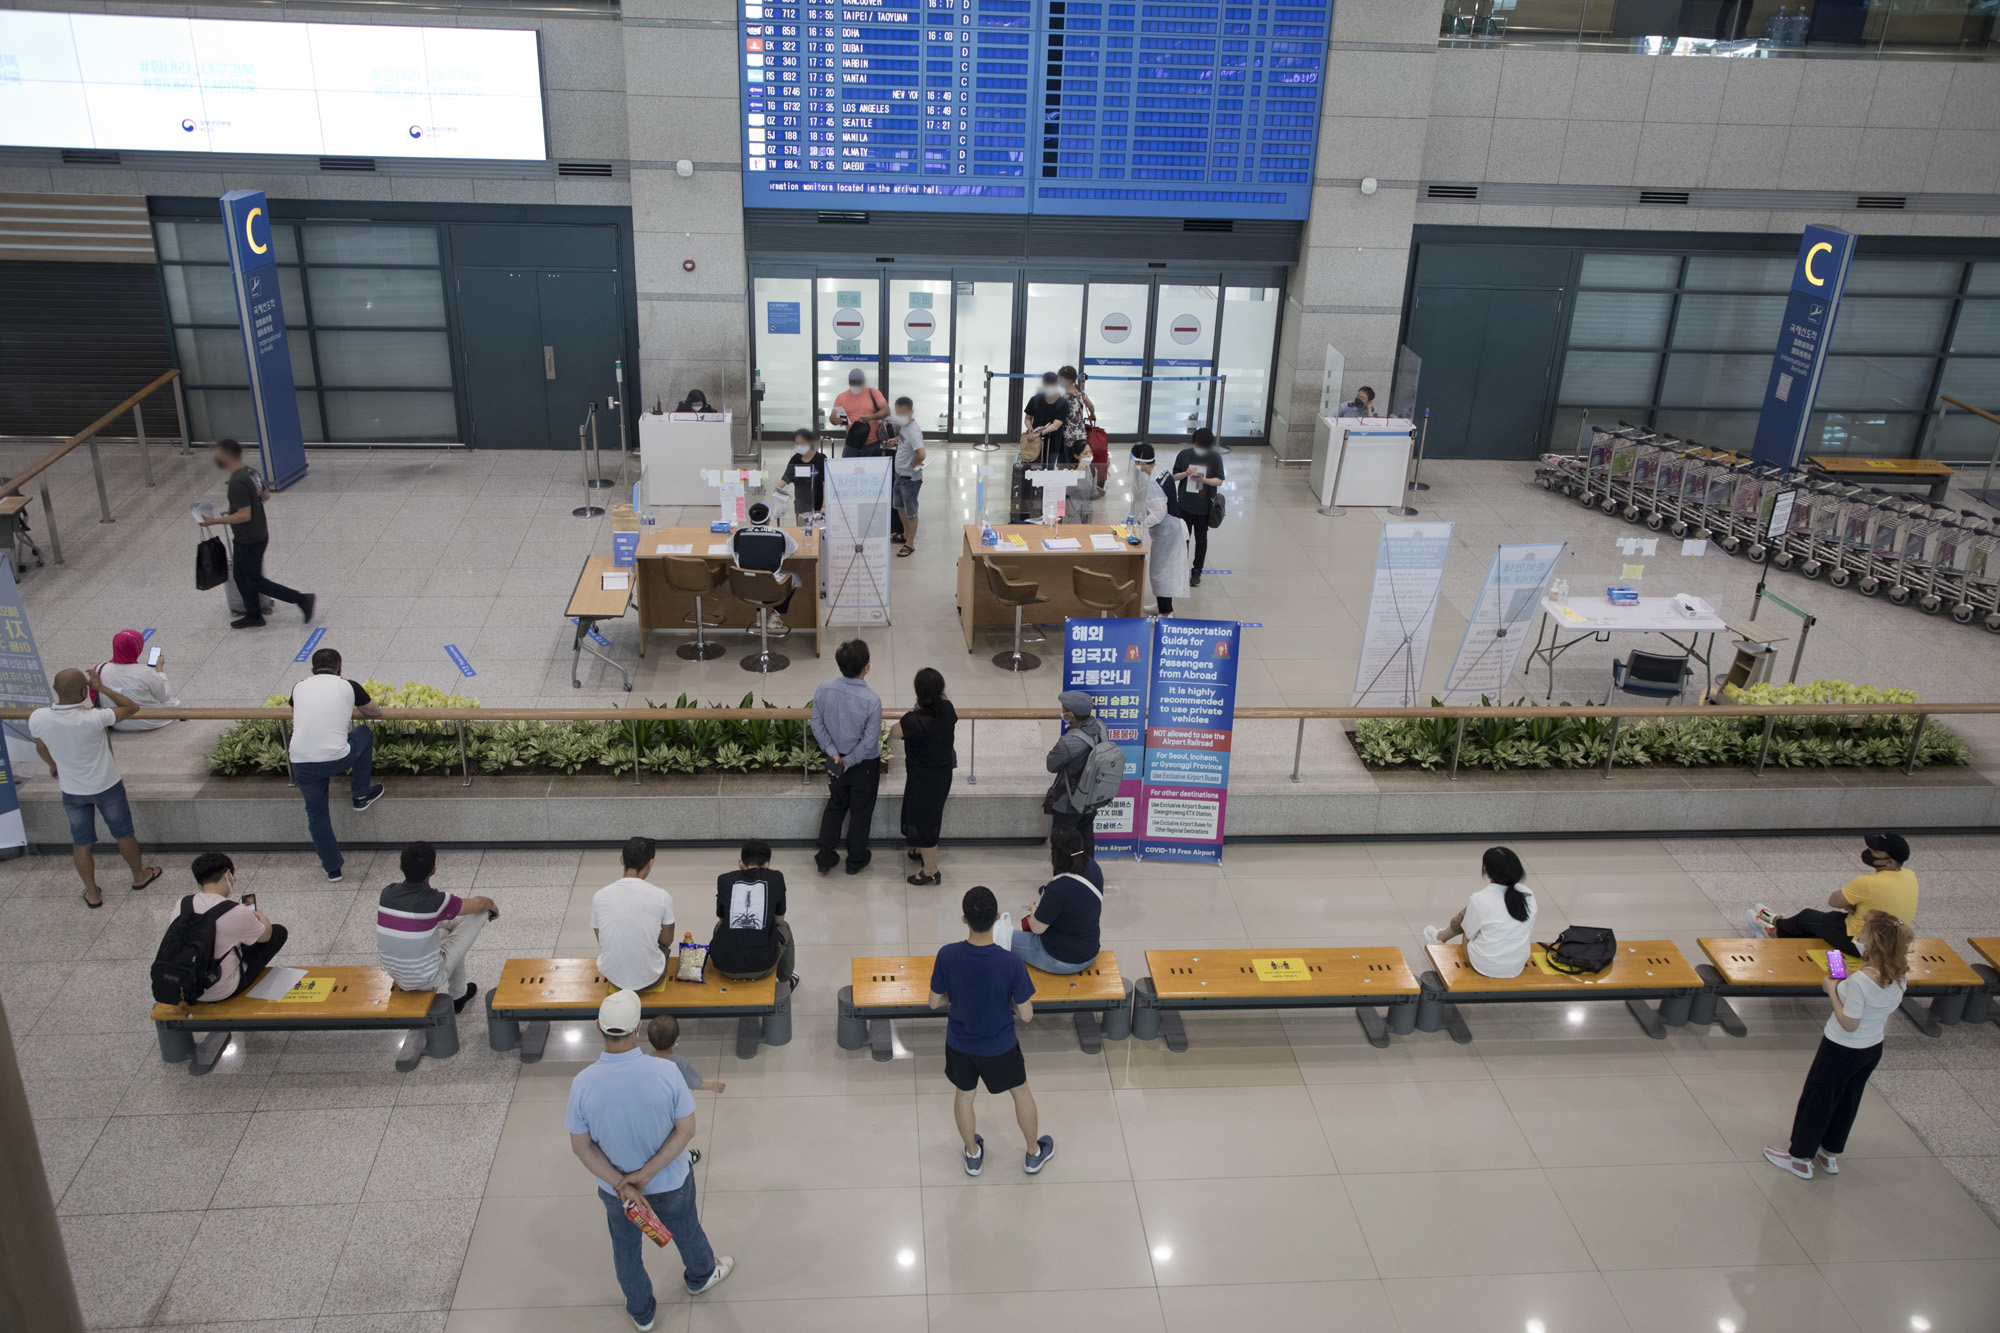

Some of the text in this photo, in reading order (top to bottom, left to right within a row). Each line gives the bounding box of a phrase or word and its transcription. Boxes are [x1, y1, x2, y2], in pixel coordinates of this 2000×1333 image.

[964, 0, 970, 8] D
[764, 8, 774, 18] OZ
[782, 8, 796, 18] 712
[808, 10, 834, 19] 16:55
[877, 12, 908, 22] TAOYUAN
[963, 16, 969, 24] D
[764, 26, 774, 35] QR
[782, 26, 796, 35] 858
[808, 28, 834, 36] 16:55
[842, 28, 860, 38] DOHA
[928, 31, 953, 40] 16:03
[962, 32, 968, 41] D
[766, 42, 968, 56] EK 322 17:00 DUBAI D
[766, 56, 968, 71] OZ 340 17:05 HARBIN C
[766, 72, 968, 86] RS 832 17:05 YANTAI C
[766, 86, 966, 101] TG 6746 17:20 NEW 16:49 C
[767, 102, 966, 116] TG 6732 17:35 LOS ANGELES 16:49 C
[766, 116, 966, 130] OZ 271 17:45 SEATTLE 17:21 D
[767, 131, 966, 144] 5J 188 18:05 MANILA C
[768, 146, 966, 159] OZ 578 18:05 ALMATY D
[768, 160, 965, 173] TW 684 18:05 DAEGU C
[803, 183, 834, 192] monitors
[837, 182, 864, 192] located
[868, 184, 874, 192] in
[879, 184, 890, 193] the
[894, 184, 920, 194] arrival
[924, 185, 943, 195] hall.
[246, 207, 268, 254] C
[1805, 242, 1832, 286] C
[1072, 626, 1104, 642] 해외
[1162, 624, 1232, 636] Transportation
[1161, 636, 1204, 646] Guide for
[1071, 648, 1118, 664] 입국자
[1160, 647, 1199, 659] Arriving
[1160, 658, 1214, 670] Passengers
[1070, 670, 1131, 685] 교통안내
[1159, 669, 1217, 680] from Abroad
[1188, 687, 1216, 697] highly
[1111, 696, 1140, 706] 승용차
[1160, 697, 1224, 706] recommended
[1099, 709, 1139, 719] 적극 권장
[1190, 706, 1222, 715] private
[1172, 715, 1209, 723] vehicles
[1162, 738, 1213, 747] Airport Railroad
[1190, 753, 1218, 762] Incheon,
[1160, 761, 1192, 770] Gyeonggi
[1193, 762, 1222, 770] Province
[1180, 790, 1218, 798] destinations
